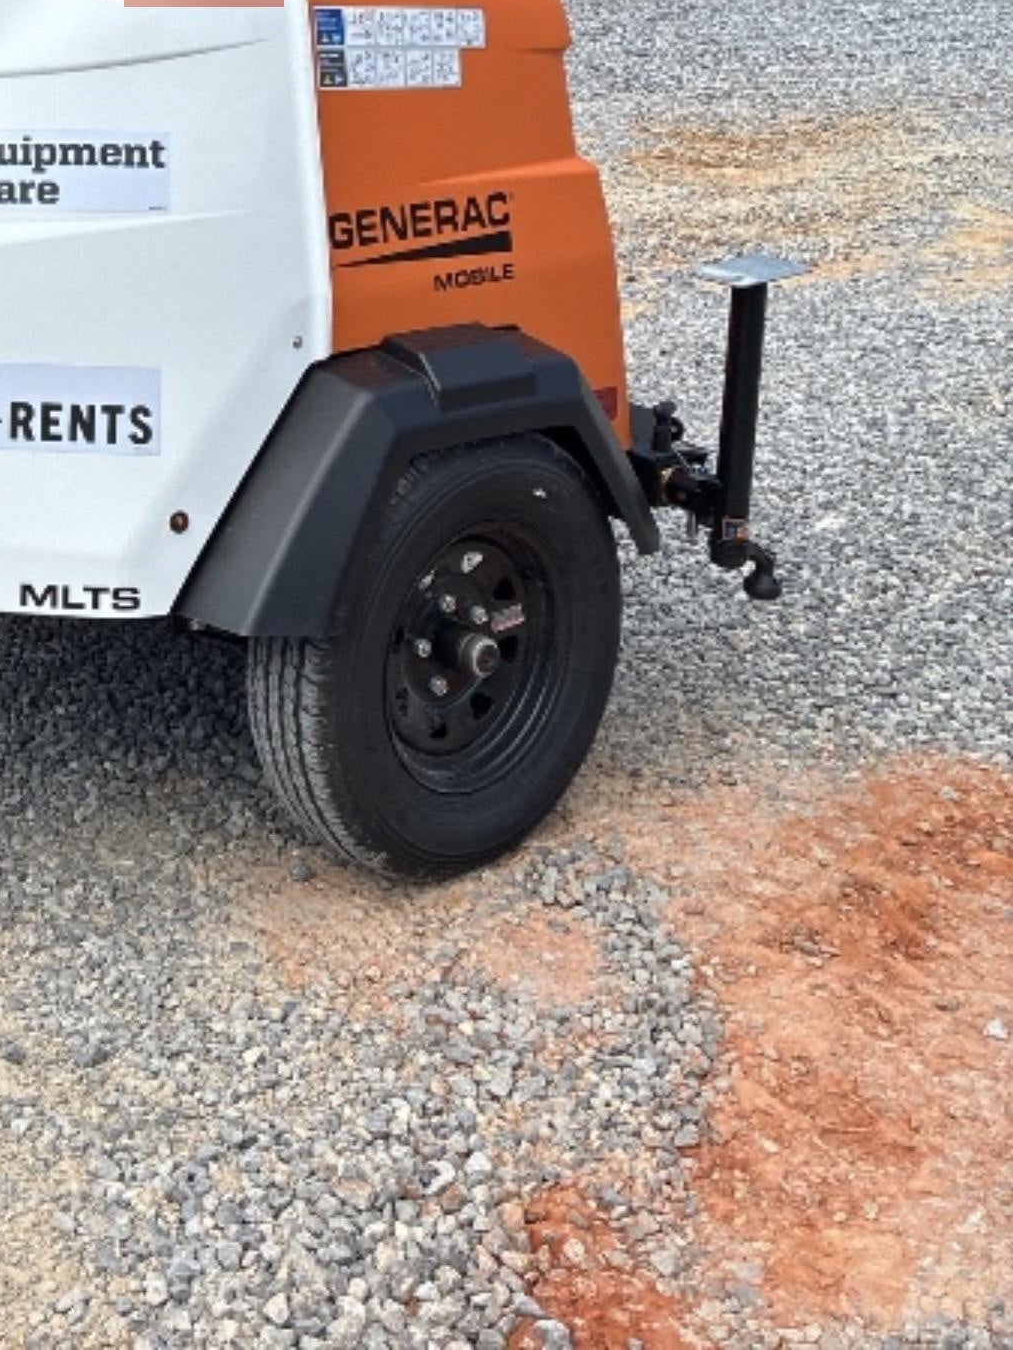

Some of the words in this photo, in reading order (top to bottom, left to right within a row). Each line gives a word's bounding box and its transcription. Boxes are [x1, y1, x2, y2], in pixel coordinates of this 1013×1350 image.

[329, 191, 510, 250] GENERAC
[434, 263, 515, 292] MOBILE
[20, 583, 140, 610] MLTS
